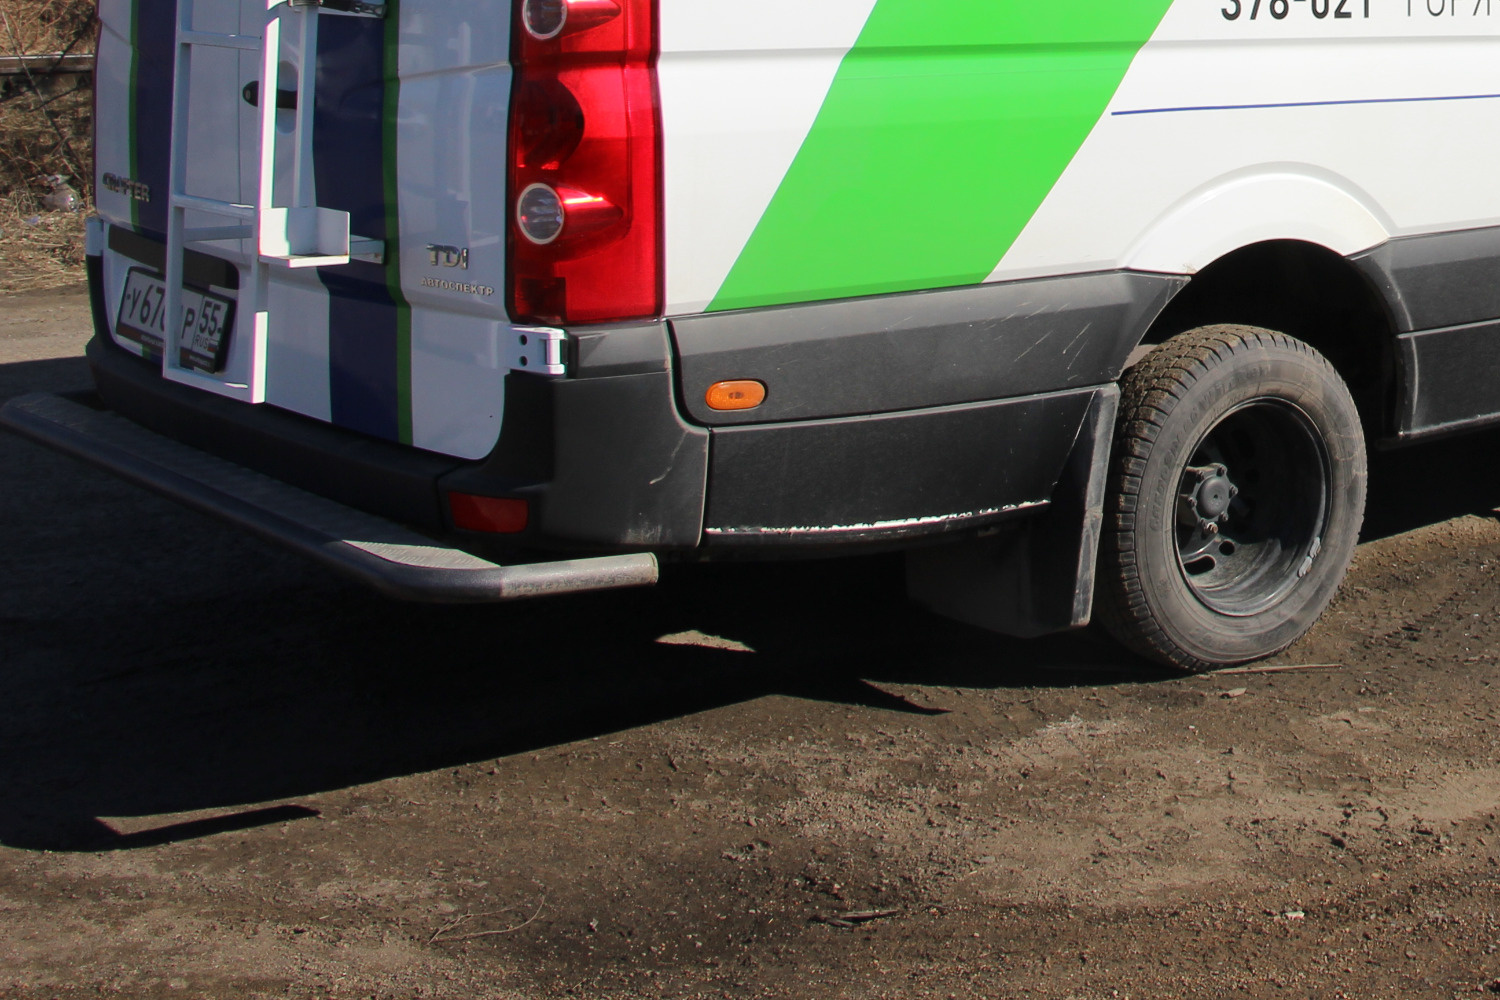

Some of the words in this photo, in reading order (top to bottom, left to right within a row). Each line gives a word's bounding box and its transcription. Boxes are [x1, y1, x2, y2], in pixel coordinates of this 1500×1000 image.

[426, 244, 469, 270] TDI
[421, 277, 495, 297] АВТОСПЕКТР
[199, 300, 221, 336] 55
